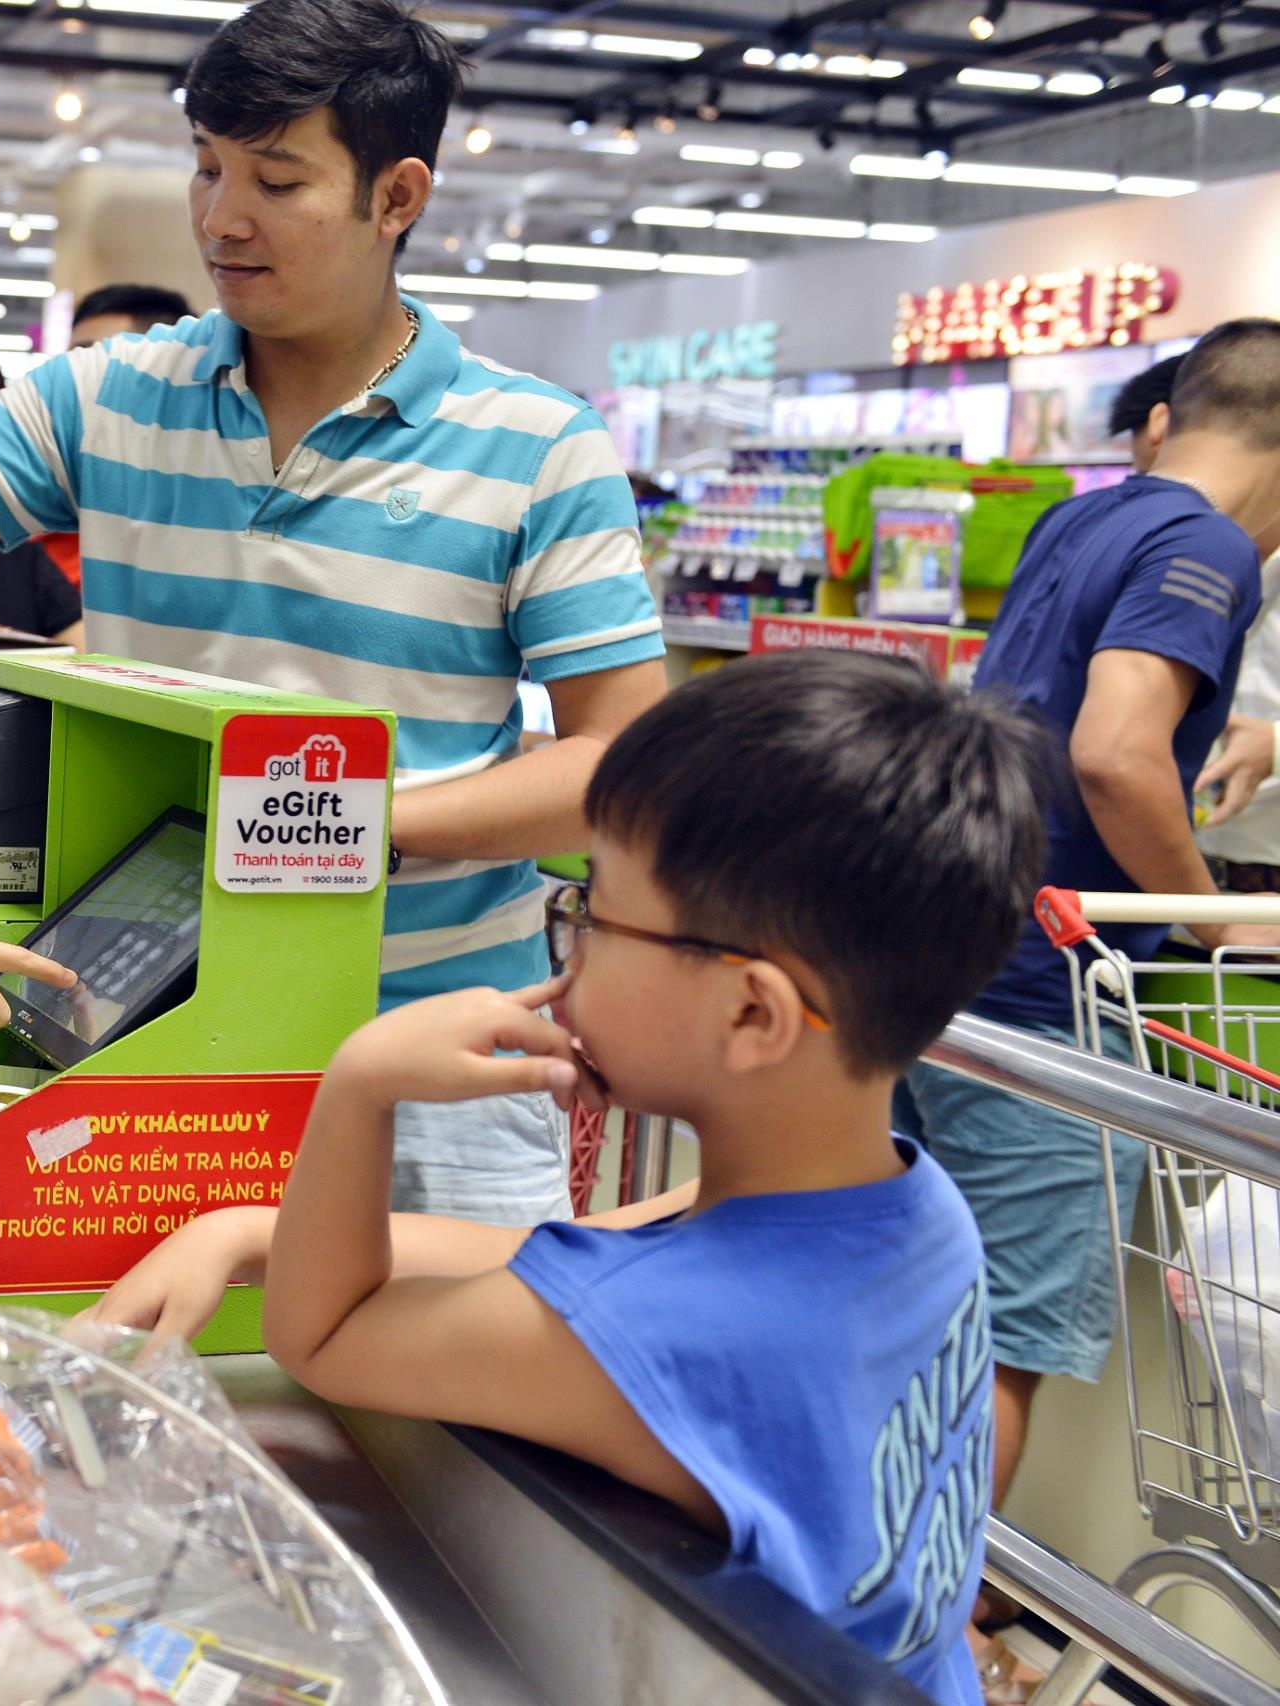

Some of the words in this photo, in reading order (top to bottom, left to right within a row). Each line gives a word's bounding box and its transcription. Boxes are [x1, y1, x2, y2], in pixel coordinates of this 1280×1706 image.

[686, 319, 779, 383] CARE
[269, 757, 301, 782] got
[315, 756, 331, 778] it
[263, 791, 342, 817] eGift
[237, 818, 366, 845] Voucher
[233, 853, 278, 867] Thanh
[282, 853, 313, 867] toán
[318, 854, 335, 870] tại
[338, 853, 365, 869] đây
[227, 875, 282, 885] www.gotit.vn
[311, 876, 331, 884] 1900
[87, 1111, 131, 1135] QUÝ
[134, 1112, 210, 1134] KHÁCH
[211, 1112, 252, 1133] LƯU
[256, 1109, 270, 1132] Ý
[66, 1149, 123, 1174] LÒNG
[130, 1145, 178, 1173] KIỂM
[185, 1152, 223, 1172] TRA
[230, 1147, 272, 1170] HÓA
[279, 1150, 298, 1169] Đ
[33, 1179, 84, 1208] TIỀN,
[91, 1180, 132, 1208] VẬT
[137, 1184, 200, 1206] DỤNG,
[207, 1177, 264, 1201] HÀNG
[270, 1181, 284, 1200] H
[72, 1216, 106, 1236] KHI
[113, 1212, 147, 1235] RỜI
